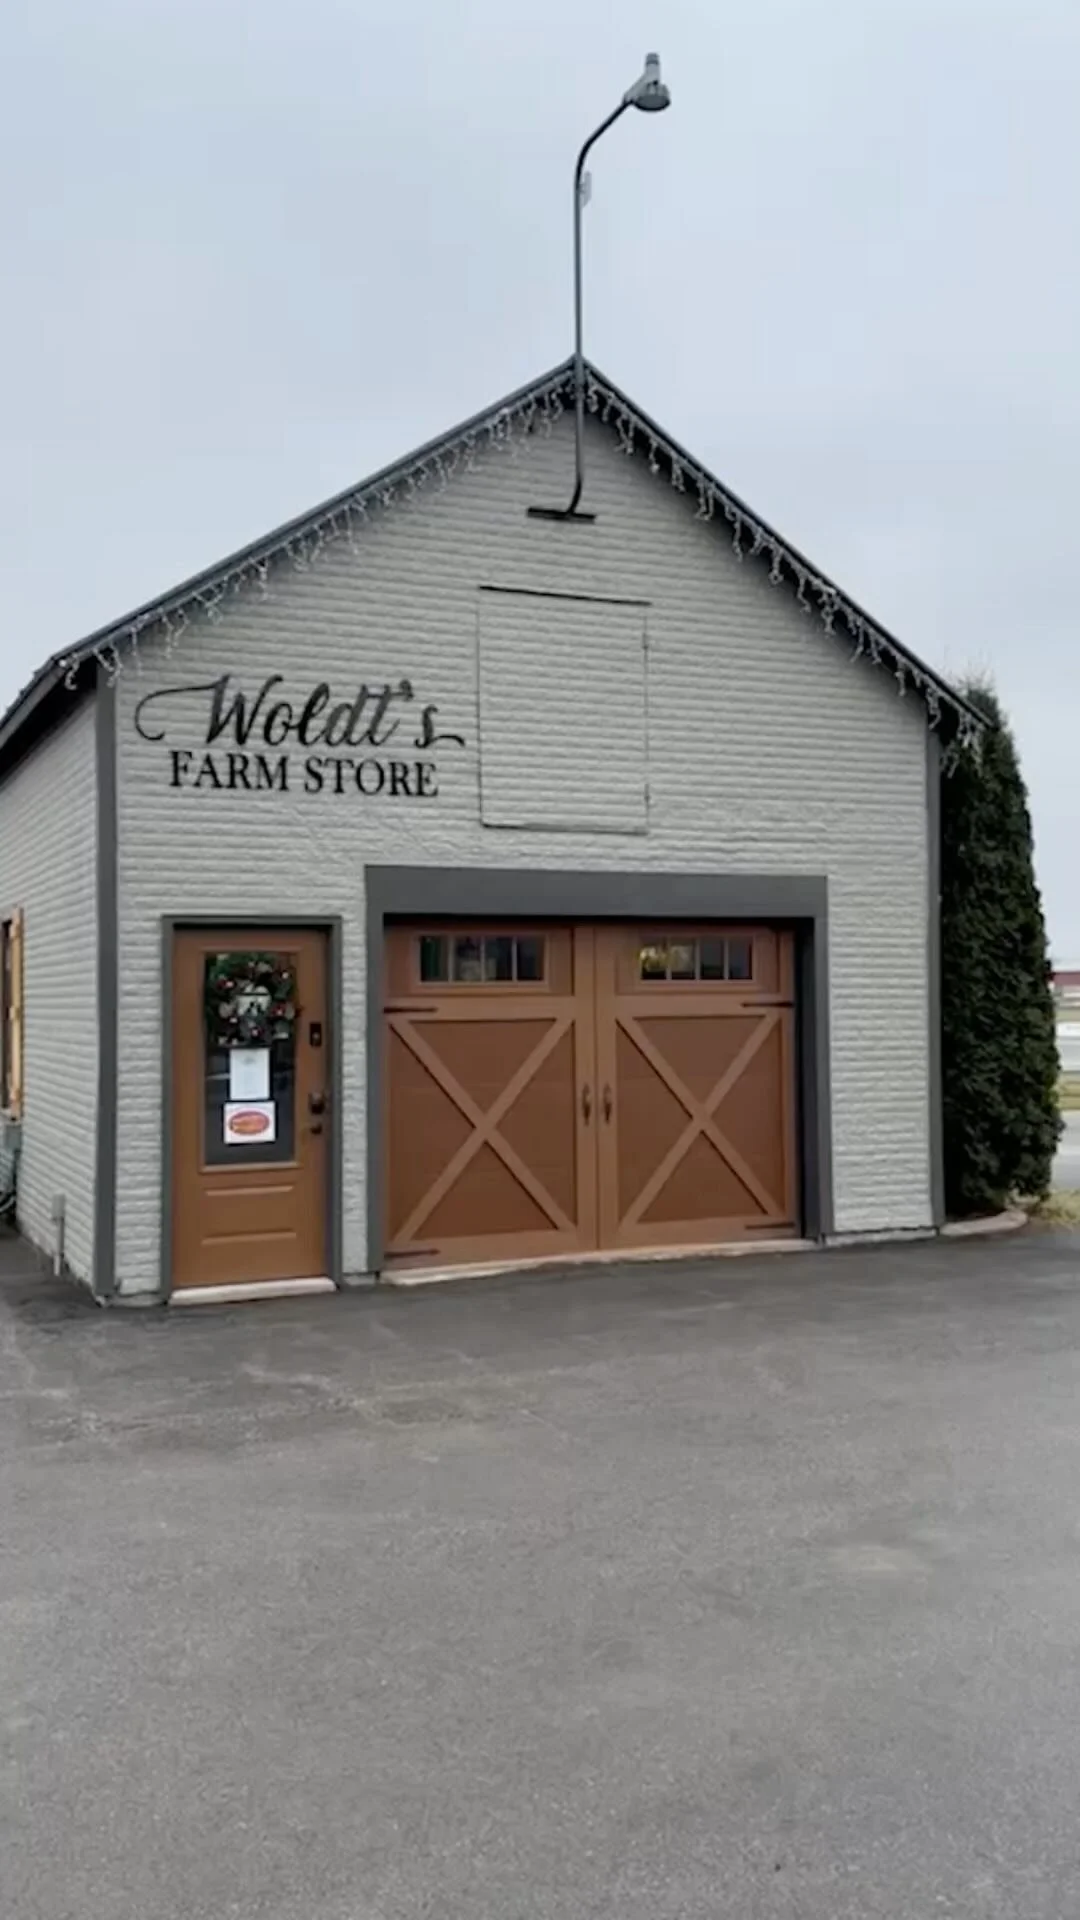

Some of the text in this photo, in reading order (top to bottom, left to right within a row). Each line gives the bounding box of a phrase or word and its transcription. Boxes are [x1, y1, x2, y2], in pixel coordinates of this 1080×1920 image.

[135, 674, 465, 748] Woldt's
[170, 751, 438, 797] FARM STORE
